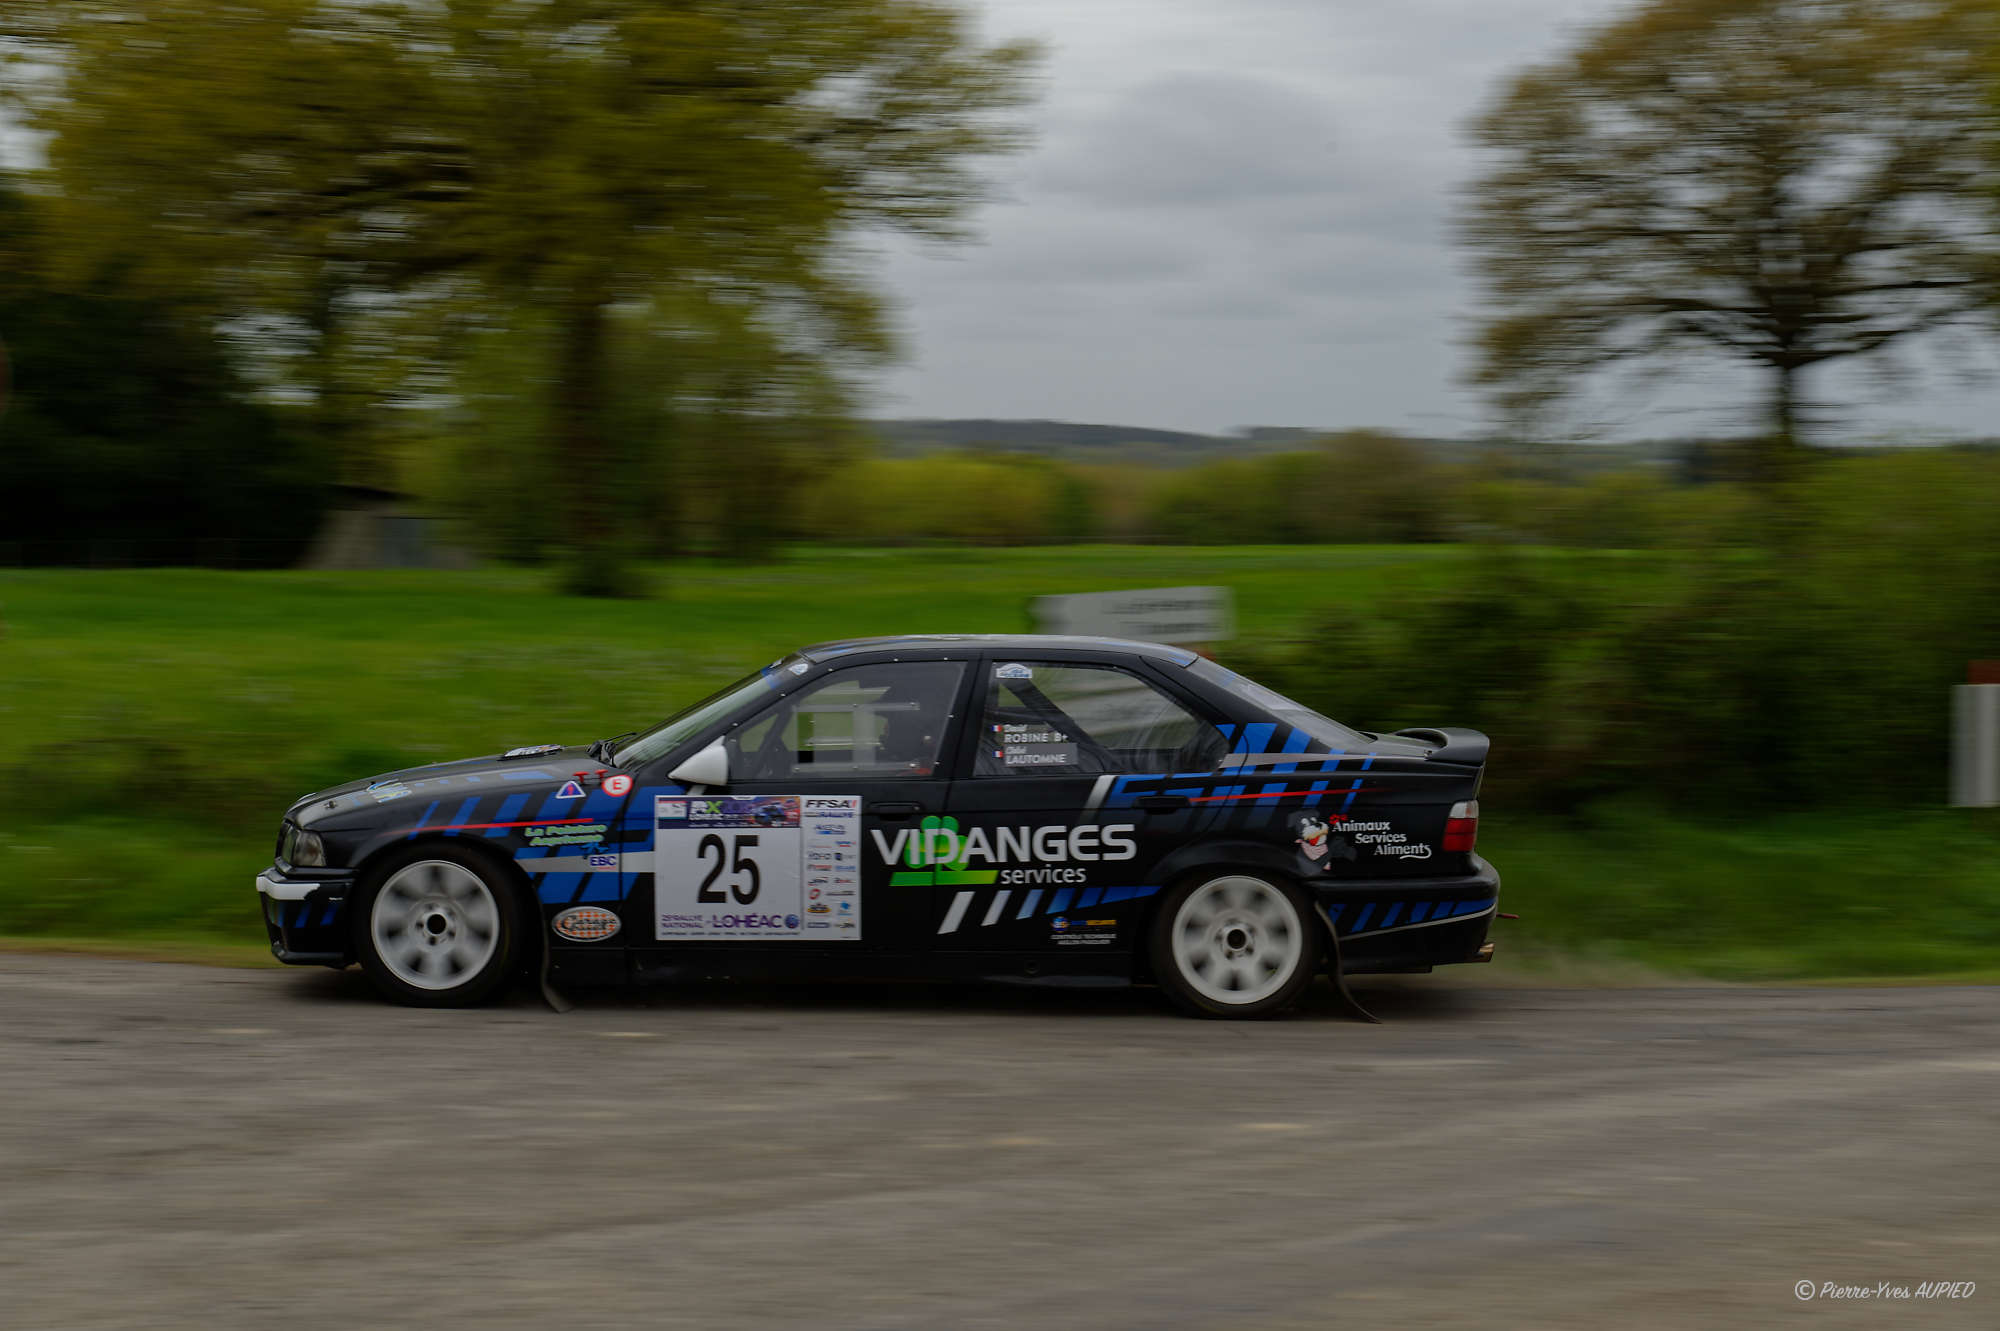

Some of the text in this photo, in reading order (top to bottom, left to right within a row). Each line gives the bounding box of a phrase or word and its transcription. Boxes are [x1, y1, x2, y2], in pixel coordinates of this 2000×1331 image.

[1004, 733, 1049, 743] ROBINE
[1006, 754, 1067, 764] LAUTOMNE
[613, 779, 622, 790] E
[806, 800, 849, 808] FFSA
[1332, 820, 1391, 832] Animaux
[1355, 831, 1407, 843] Services
[871, 824, 1138, 866] VIDANGES
[1374, 843, 1432, 859] Aliments
[590, 856, 617, 866] EBC
[696, 833, 760, 904] 25
[1000, 864, 1087, 885] services
[712, 913, 782, 928] LOHÉAC
